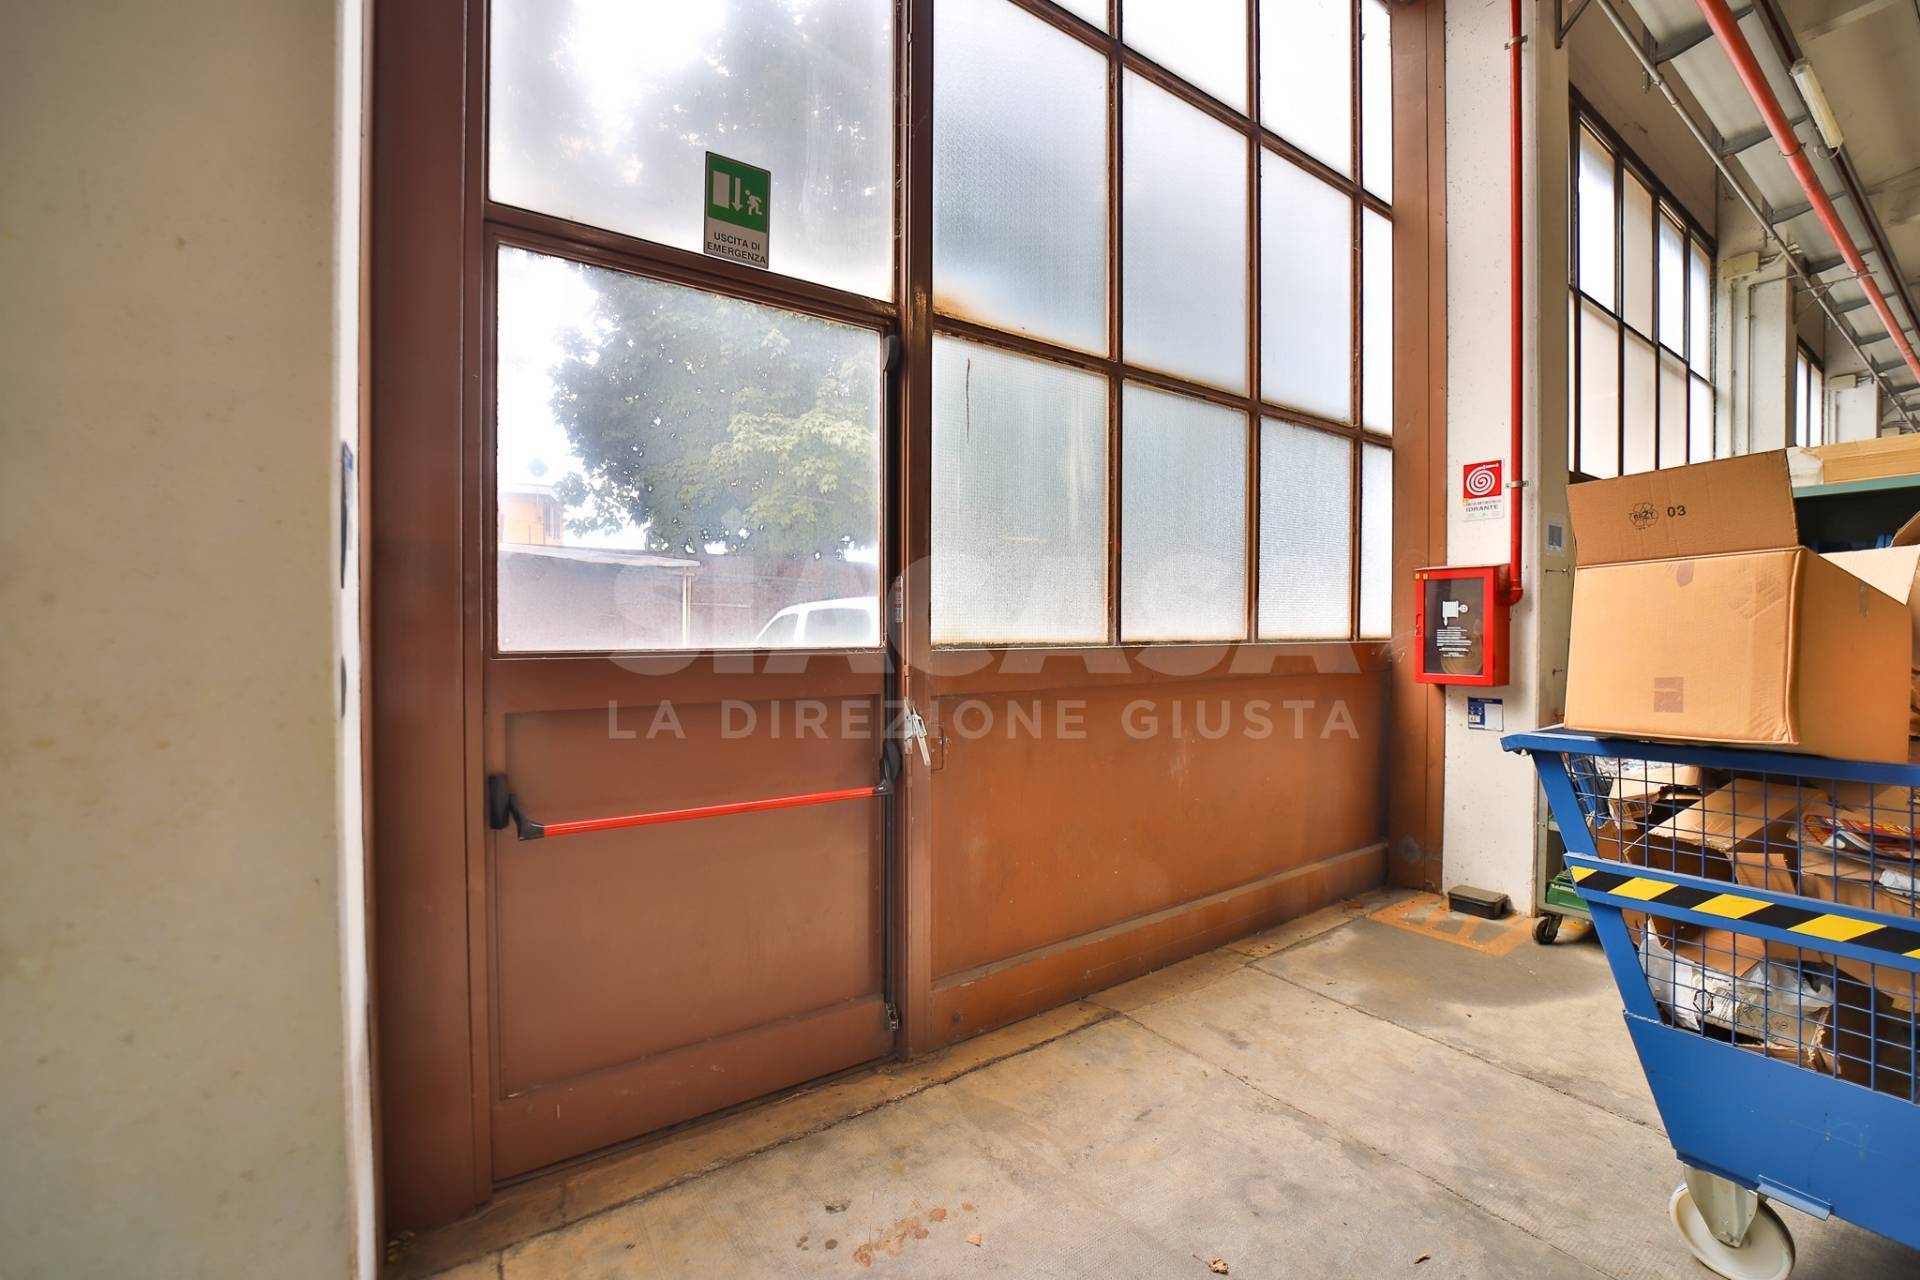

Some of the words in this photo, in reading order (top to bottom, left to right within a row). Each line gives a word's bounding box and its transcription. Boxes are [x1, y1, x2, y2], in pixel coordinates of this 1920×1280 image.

[714, 232, 748, 248] USCITA
[751, 241, 761, 251] DI
[707, 241, 766, 264] EMERGENZA
[1465, 504, 1498, 512] IDRANTE
[1667, 504, 1687, 518] 03
